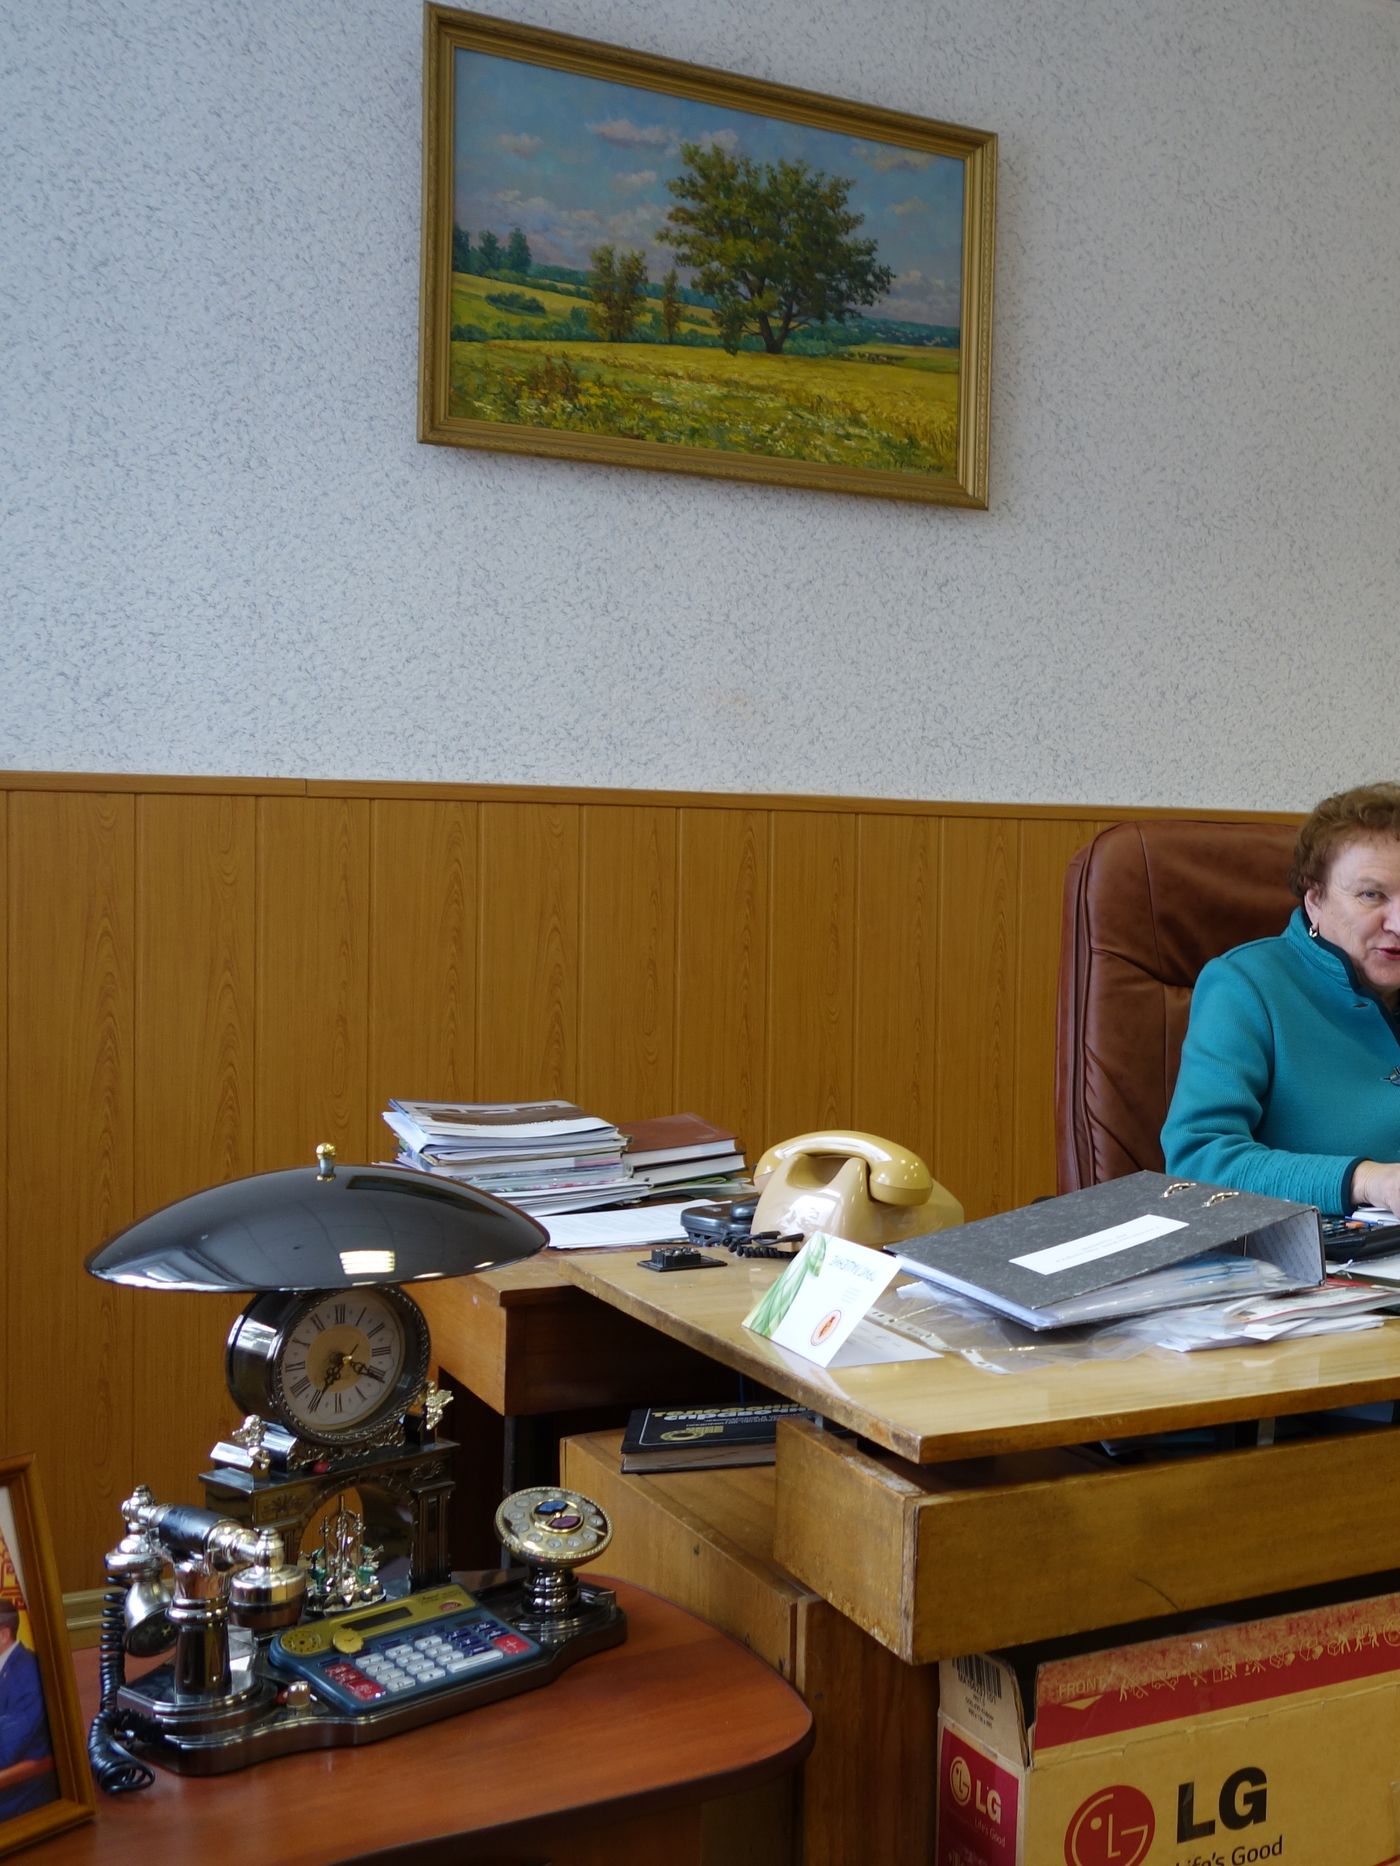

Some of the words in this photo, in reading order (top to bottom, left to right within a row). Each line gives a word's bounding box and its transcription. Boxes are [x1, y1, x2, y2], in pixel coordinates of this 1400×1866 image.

[975, 1779, 1002, 1825] LG
[1176, 1766, 1268, 1844] LG
[1231, 1834, 1283, 1866] Good
